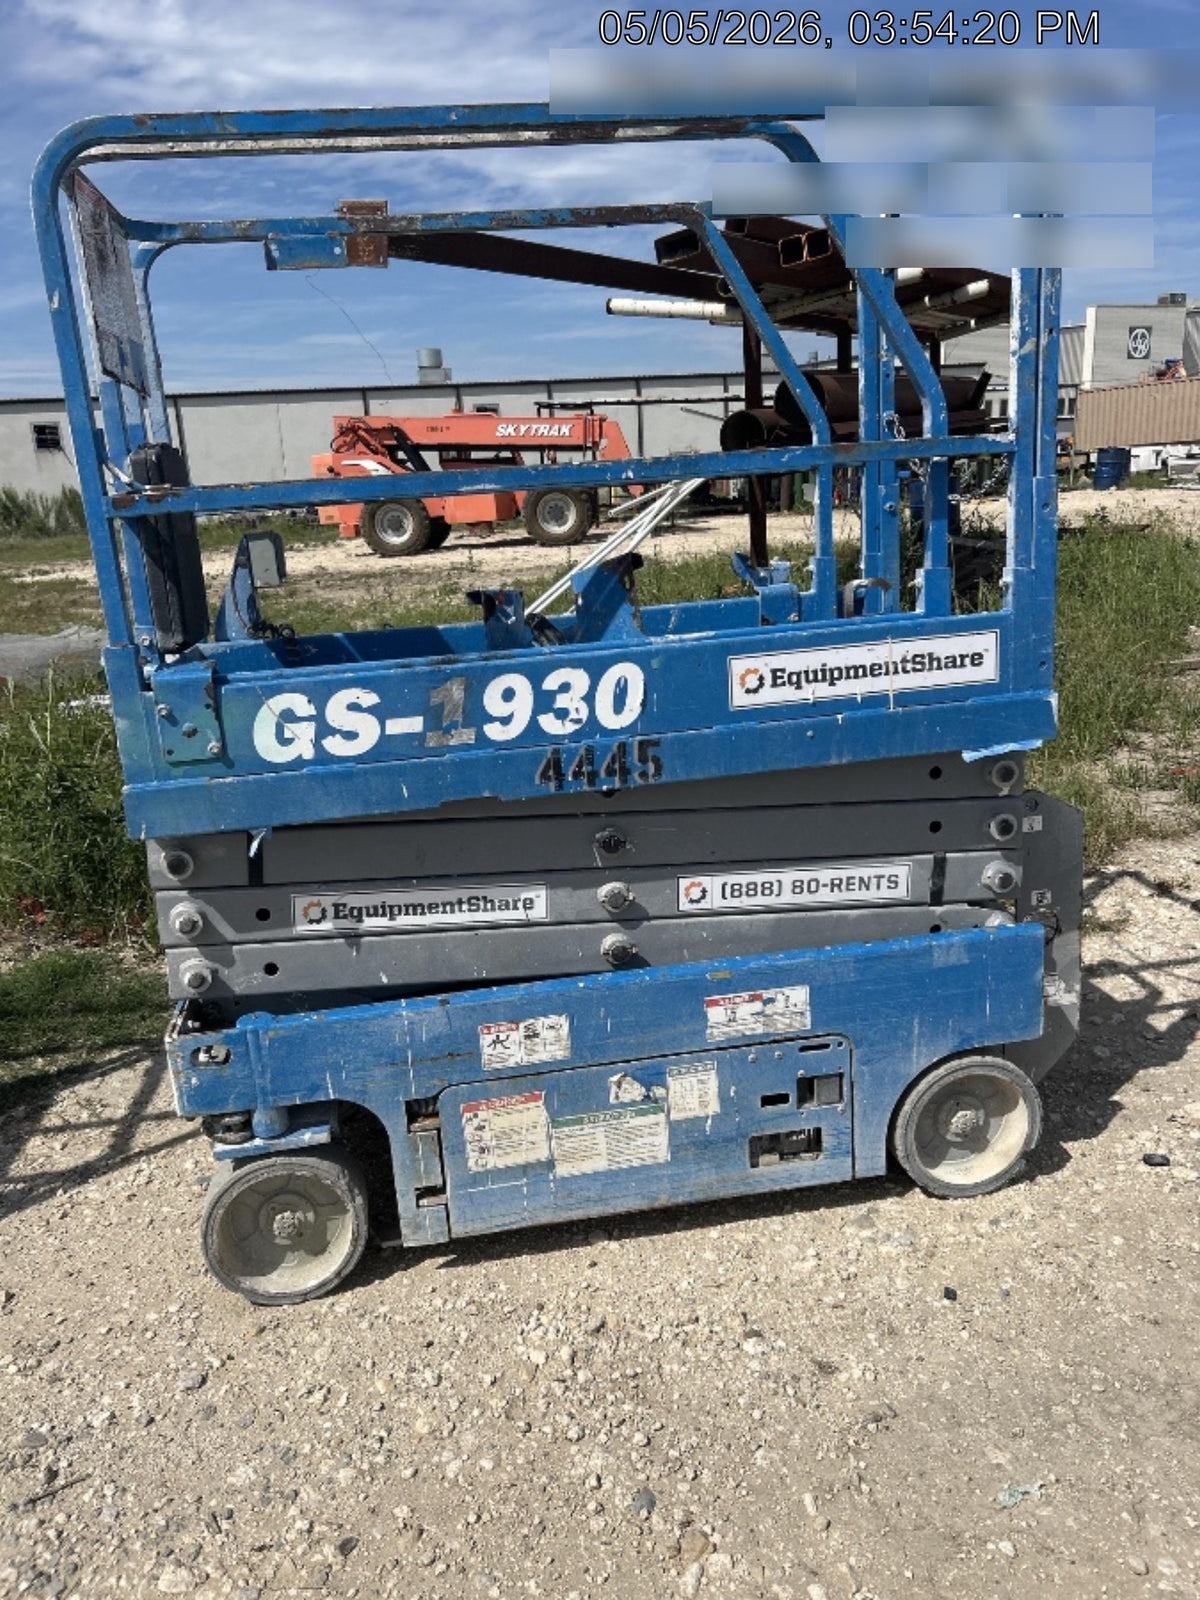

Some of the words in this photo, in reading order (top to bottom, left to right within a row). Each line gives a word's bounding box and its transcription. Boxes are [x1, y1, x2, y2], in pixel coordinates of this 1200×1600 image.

[495, 423, 573, 437] SKYTRAK
[769, 651, 985, 690] EquipmentShare
[252, 661, 645, 764] GS-1930
[534, 738, 664, 792] 4445
[721, 879, 783, 900] (888)
[790, 873, 900, 896] 80-RENTS
[331, 895, 535, 924] EquipmentShare
